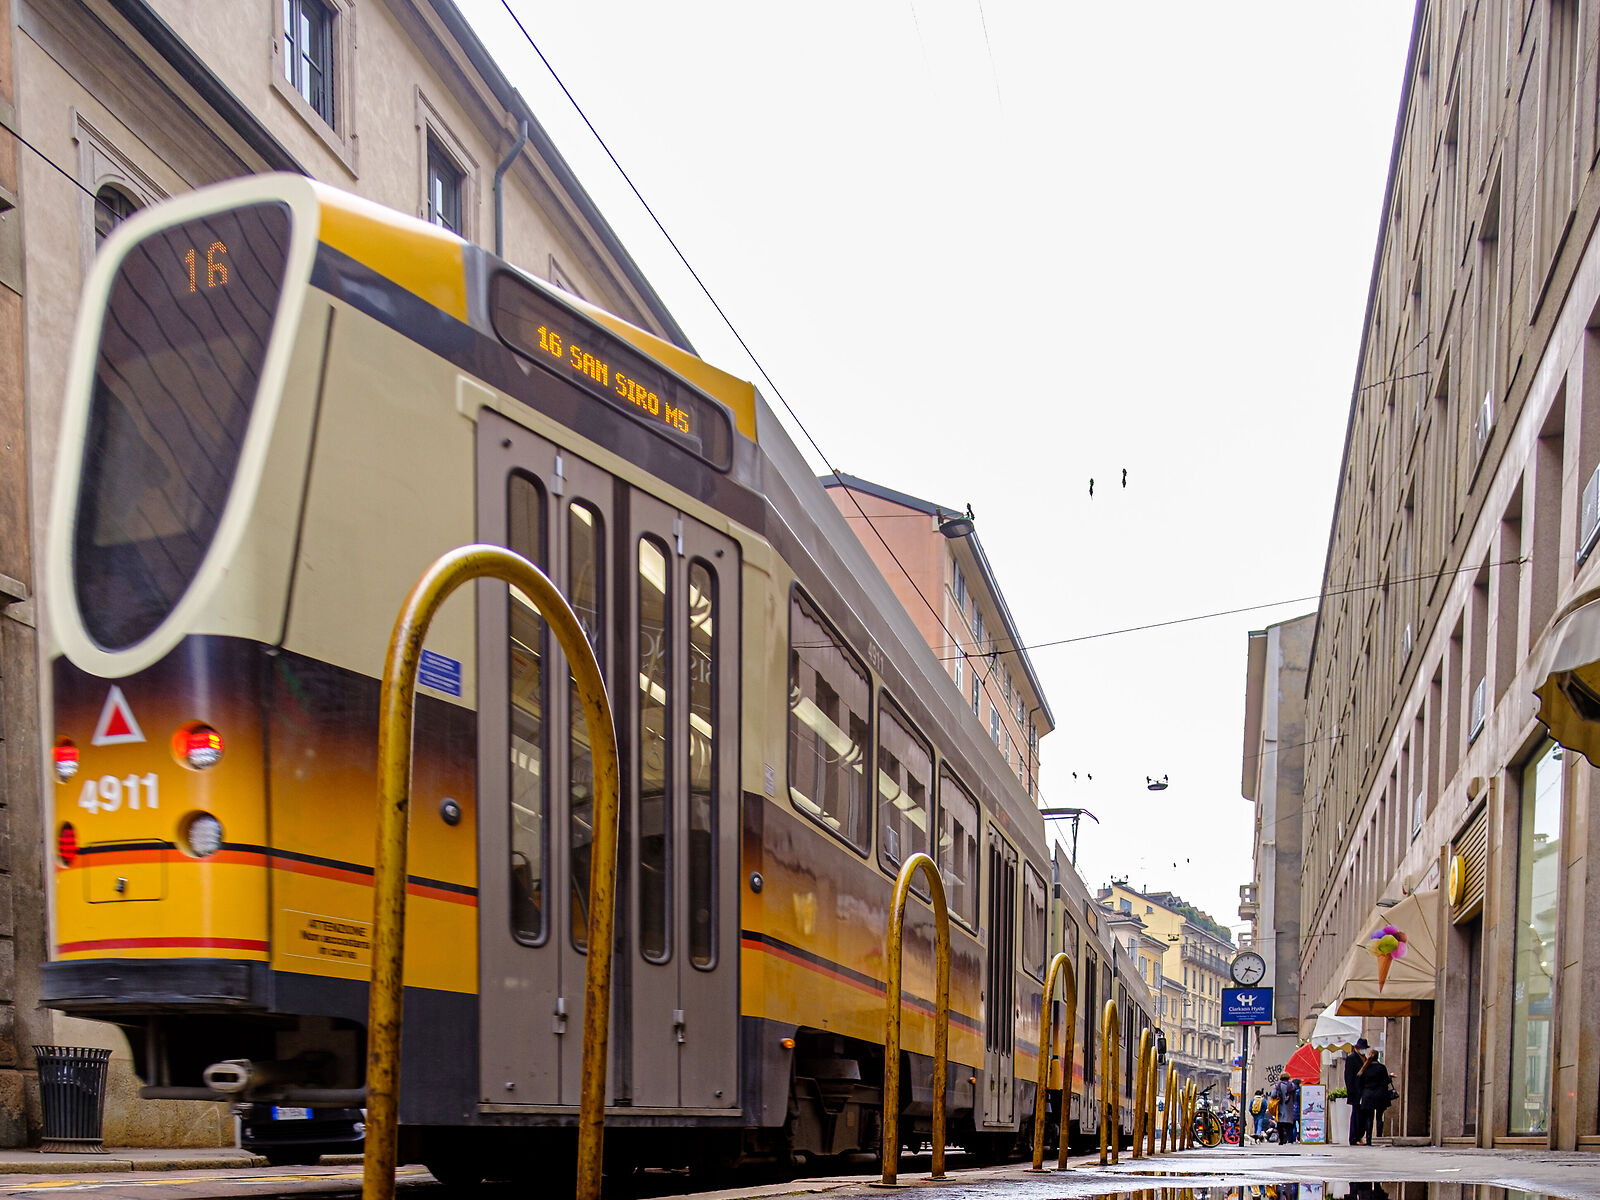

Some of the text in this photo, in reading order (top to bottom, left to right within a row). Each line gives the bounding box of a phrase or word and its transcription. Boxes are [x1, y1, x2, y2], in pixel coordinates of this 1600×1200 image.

[184, 241, 228, 292] 16
[537, 325, 689, 434] 16 SAN SIRO M5
[78, 772, 159, 815] 4911
